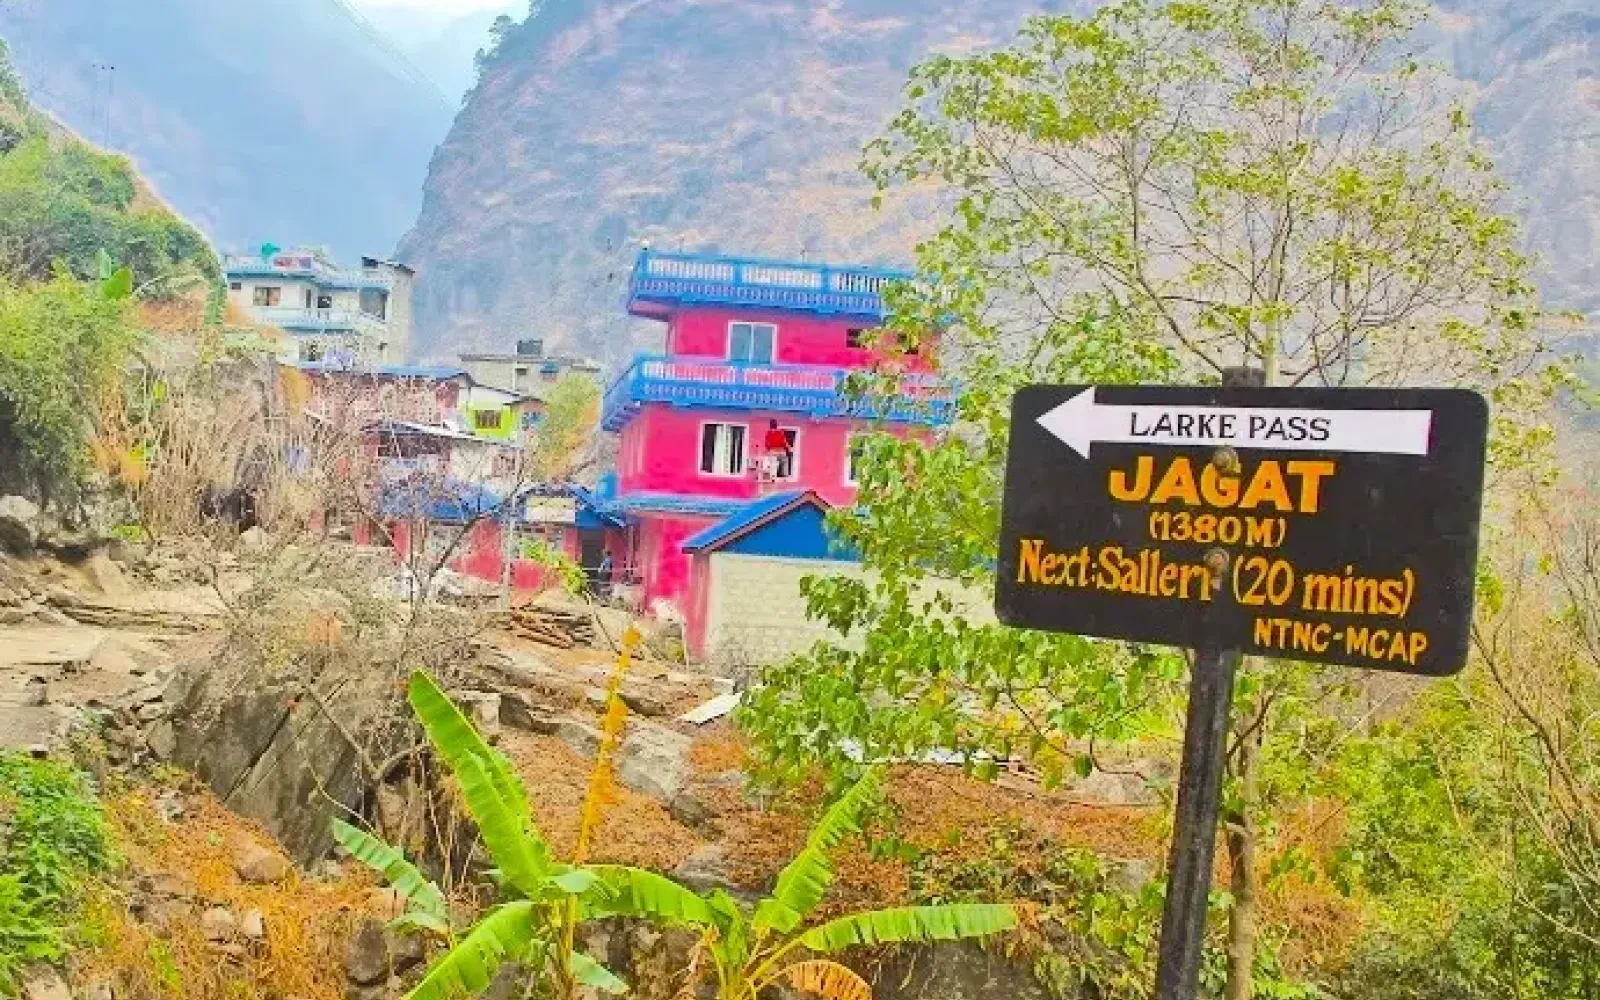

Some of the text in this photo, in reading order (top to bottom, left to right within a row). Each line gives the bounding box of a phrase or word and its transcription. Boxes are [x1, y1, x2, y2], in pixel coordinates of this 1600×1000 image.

[1129, 411, 1332, 441] LARKE PASS
[1109, 455, 1335, 513] JAGAT
[1233, 555, 1295, 606] (20
[1302, 564, 1415, 619] mins)
[1254, 618, 1428, 666] NTNC-MCAP
